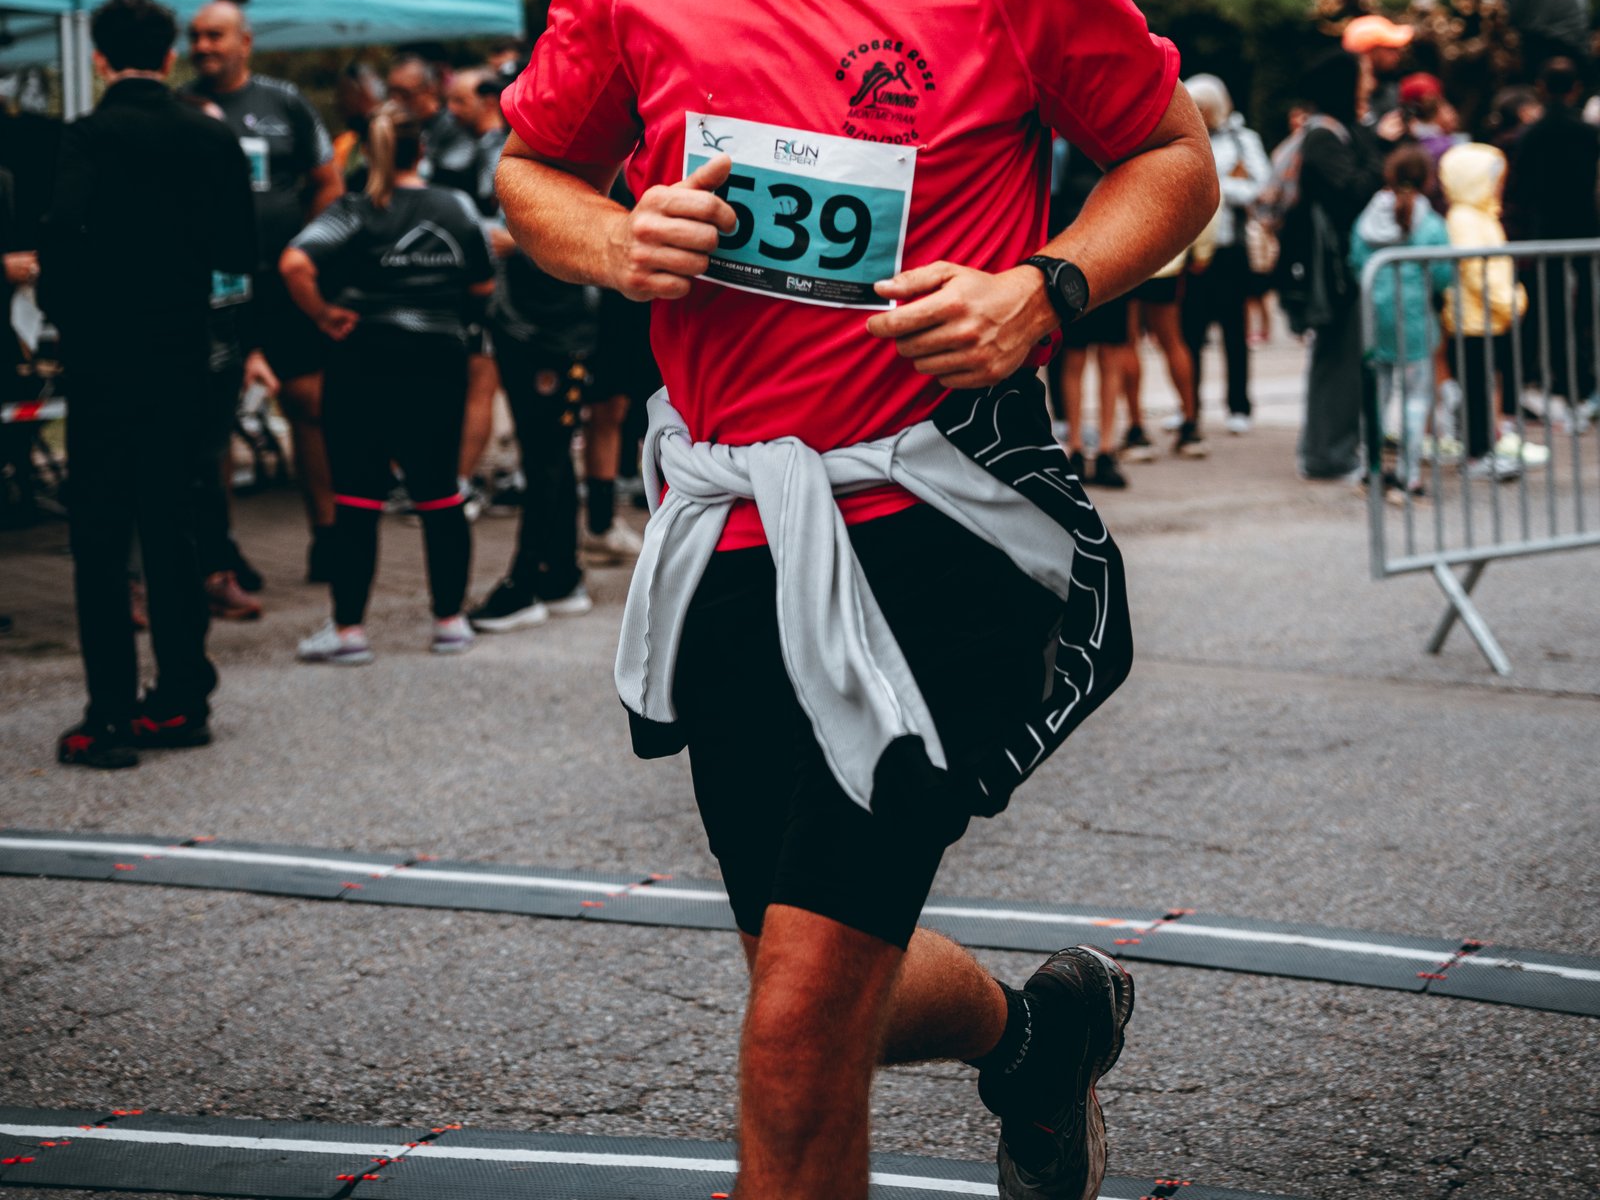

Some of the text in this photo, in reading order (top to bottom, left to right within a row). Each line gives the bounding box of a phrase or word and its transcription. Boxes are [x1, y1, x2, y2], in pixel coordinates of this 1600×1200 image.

[835, 39, 936, 91] OCTOBRE ROSE
[774, 151, 817, 167] EXPERT
[775, 139, 819, 159] RUN
[714, 173, 872, 271] 539
[786, 275, 812, 289] RUN
